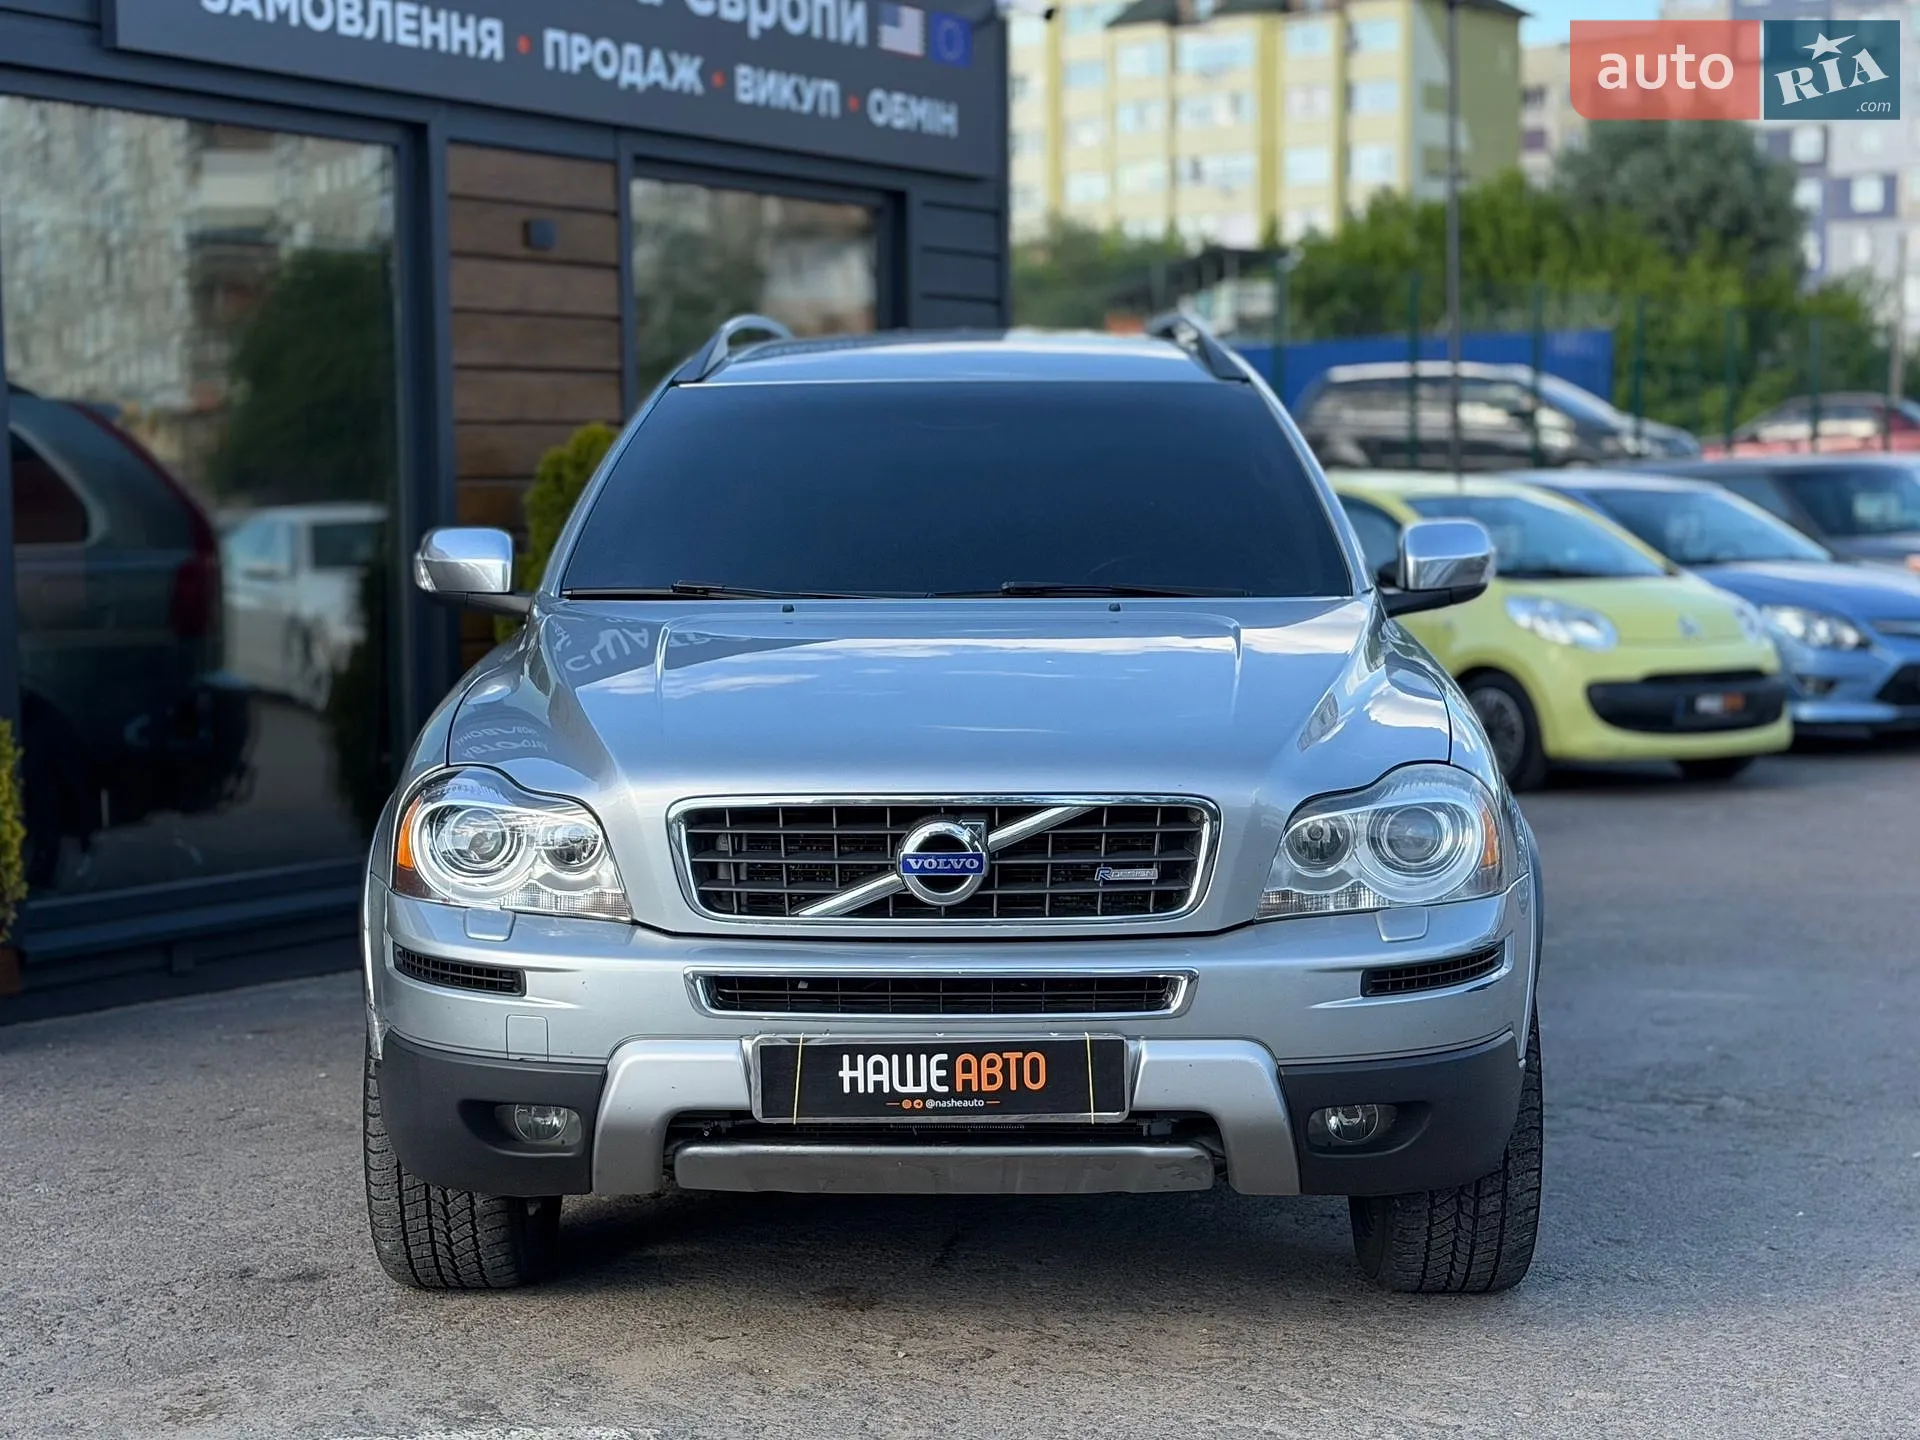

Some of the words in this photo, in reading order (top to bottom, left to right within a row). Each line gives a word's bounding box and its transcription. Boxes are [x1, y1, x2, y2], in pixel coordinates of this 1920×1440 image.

[543, 28, 704, 95] ПРОДАЖ
[734, 64, 841, 119] ВИКУП
[866, 88, 958, 138] ОБМІН
[906, 858, 979, 870] VOLVO
[838, 1053, 949, 1093] НАШЕ
[955, 1052, 1046, 1092] АВТО
[925, 1098, 985, 1109] @nasheauto
